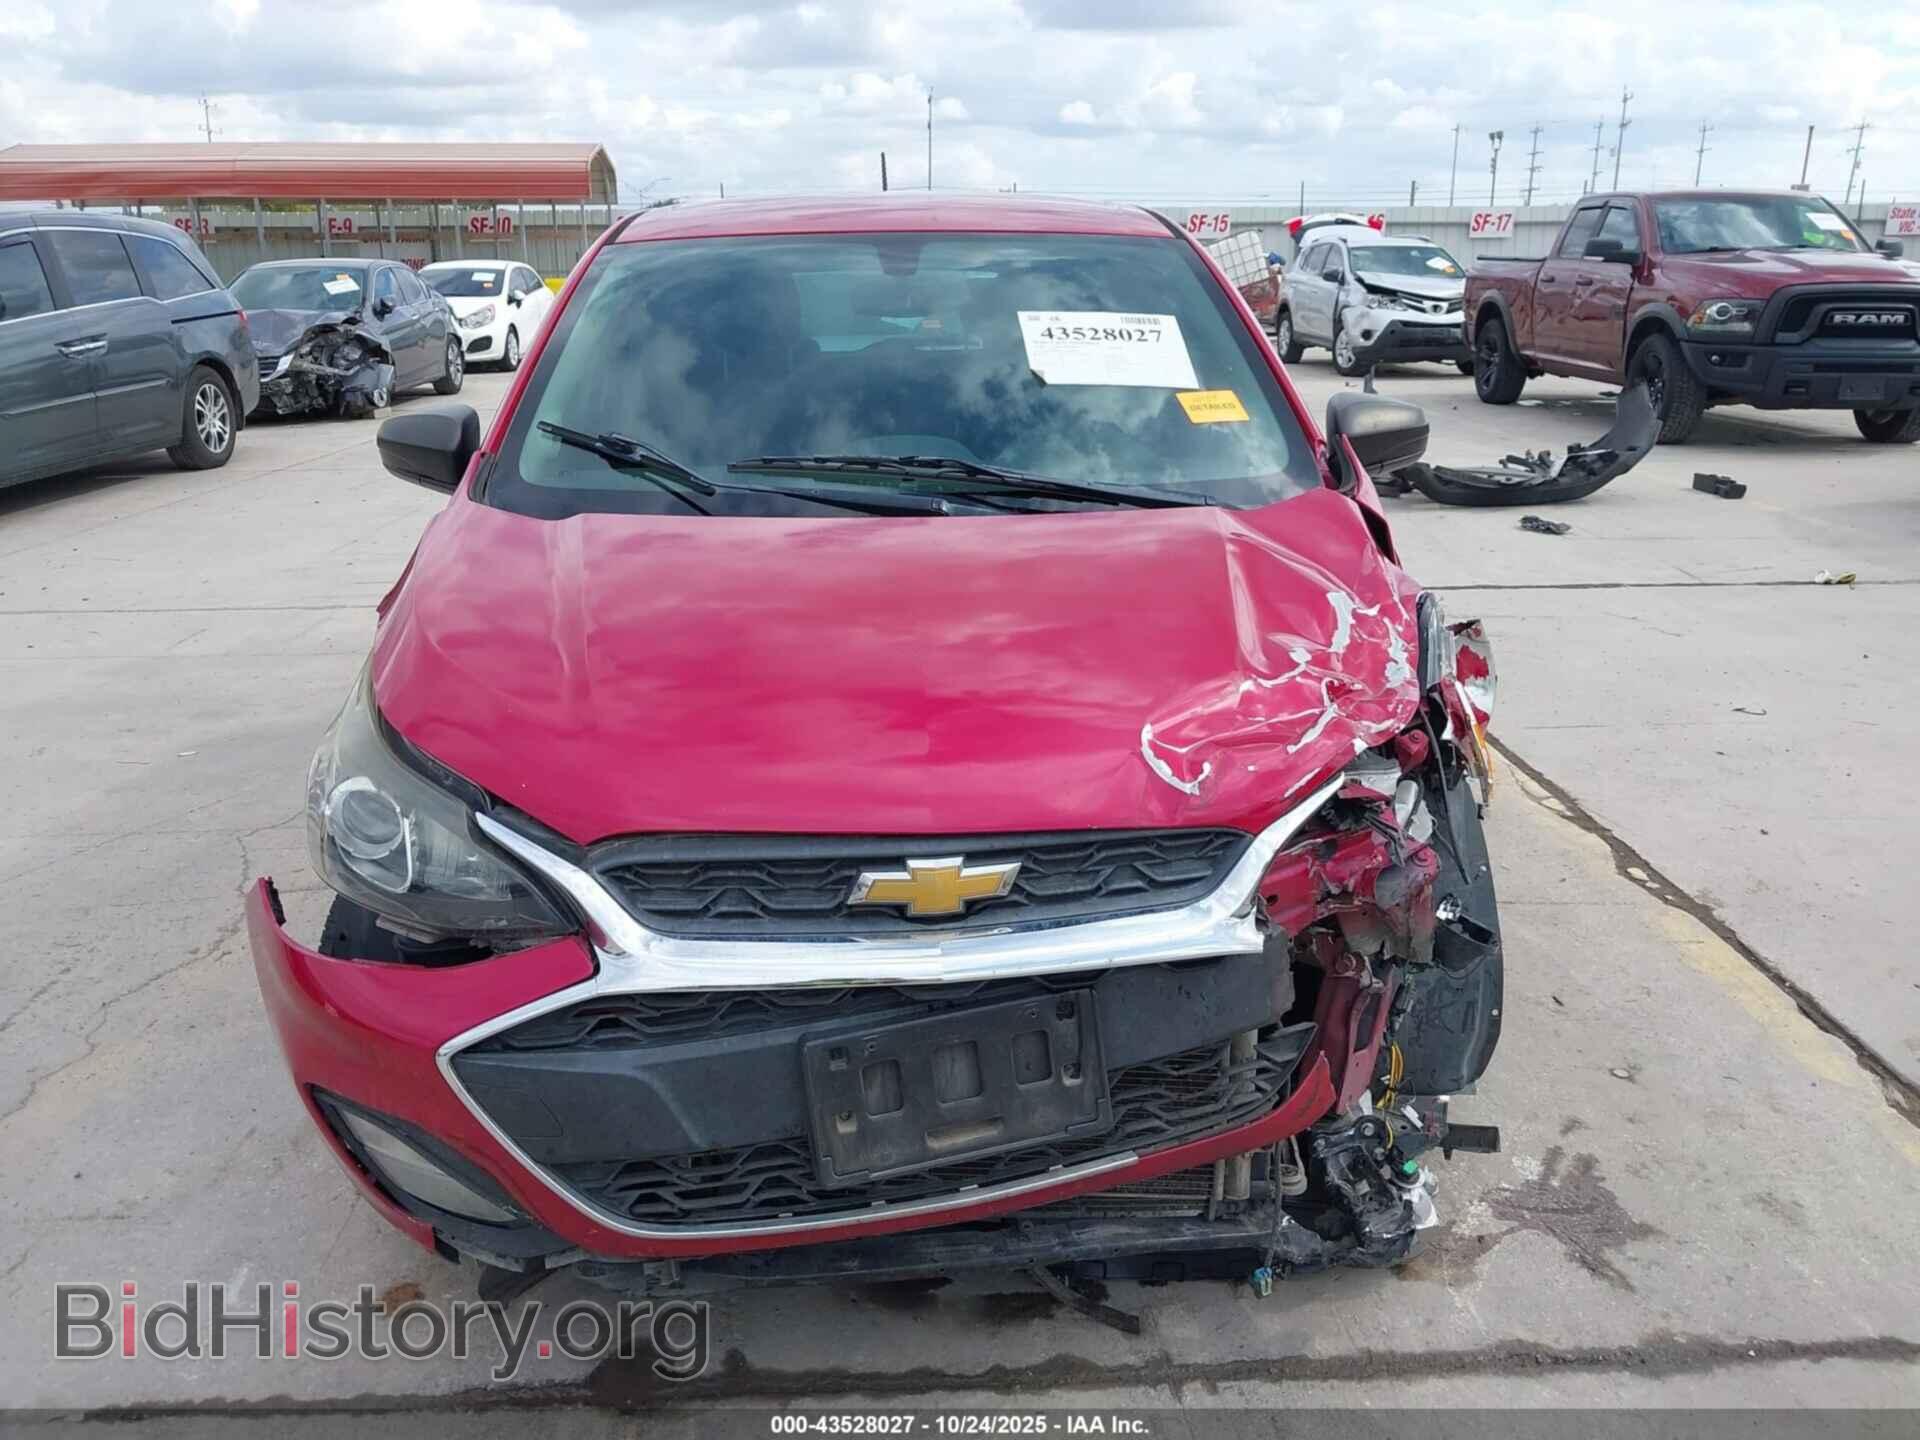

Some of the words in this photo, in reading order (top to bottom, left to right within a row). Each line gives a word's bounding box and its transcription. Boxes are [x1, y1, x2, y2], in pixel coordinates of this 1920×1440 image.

[1187, 213, 1230, 233] SF-15
[1471, 213, 1513, 232] SF-17
[1832, 313, 1905, 326] RAM
[1040, 326, 1162, 343] 43528027
